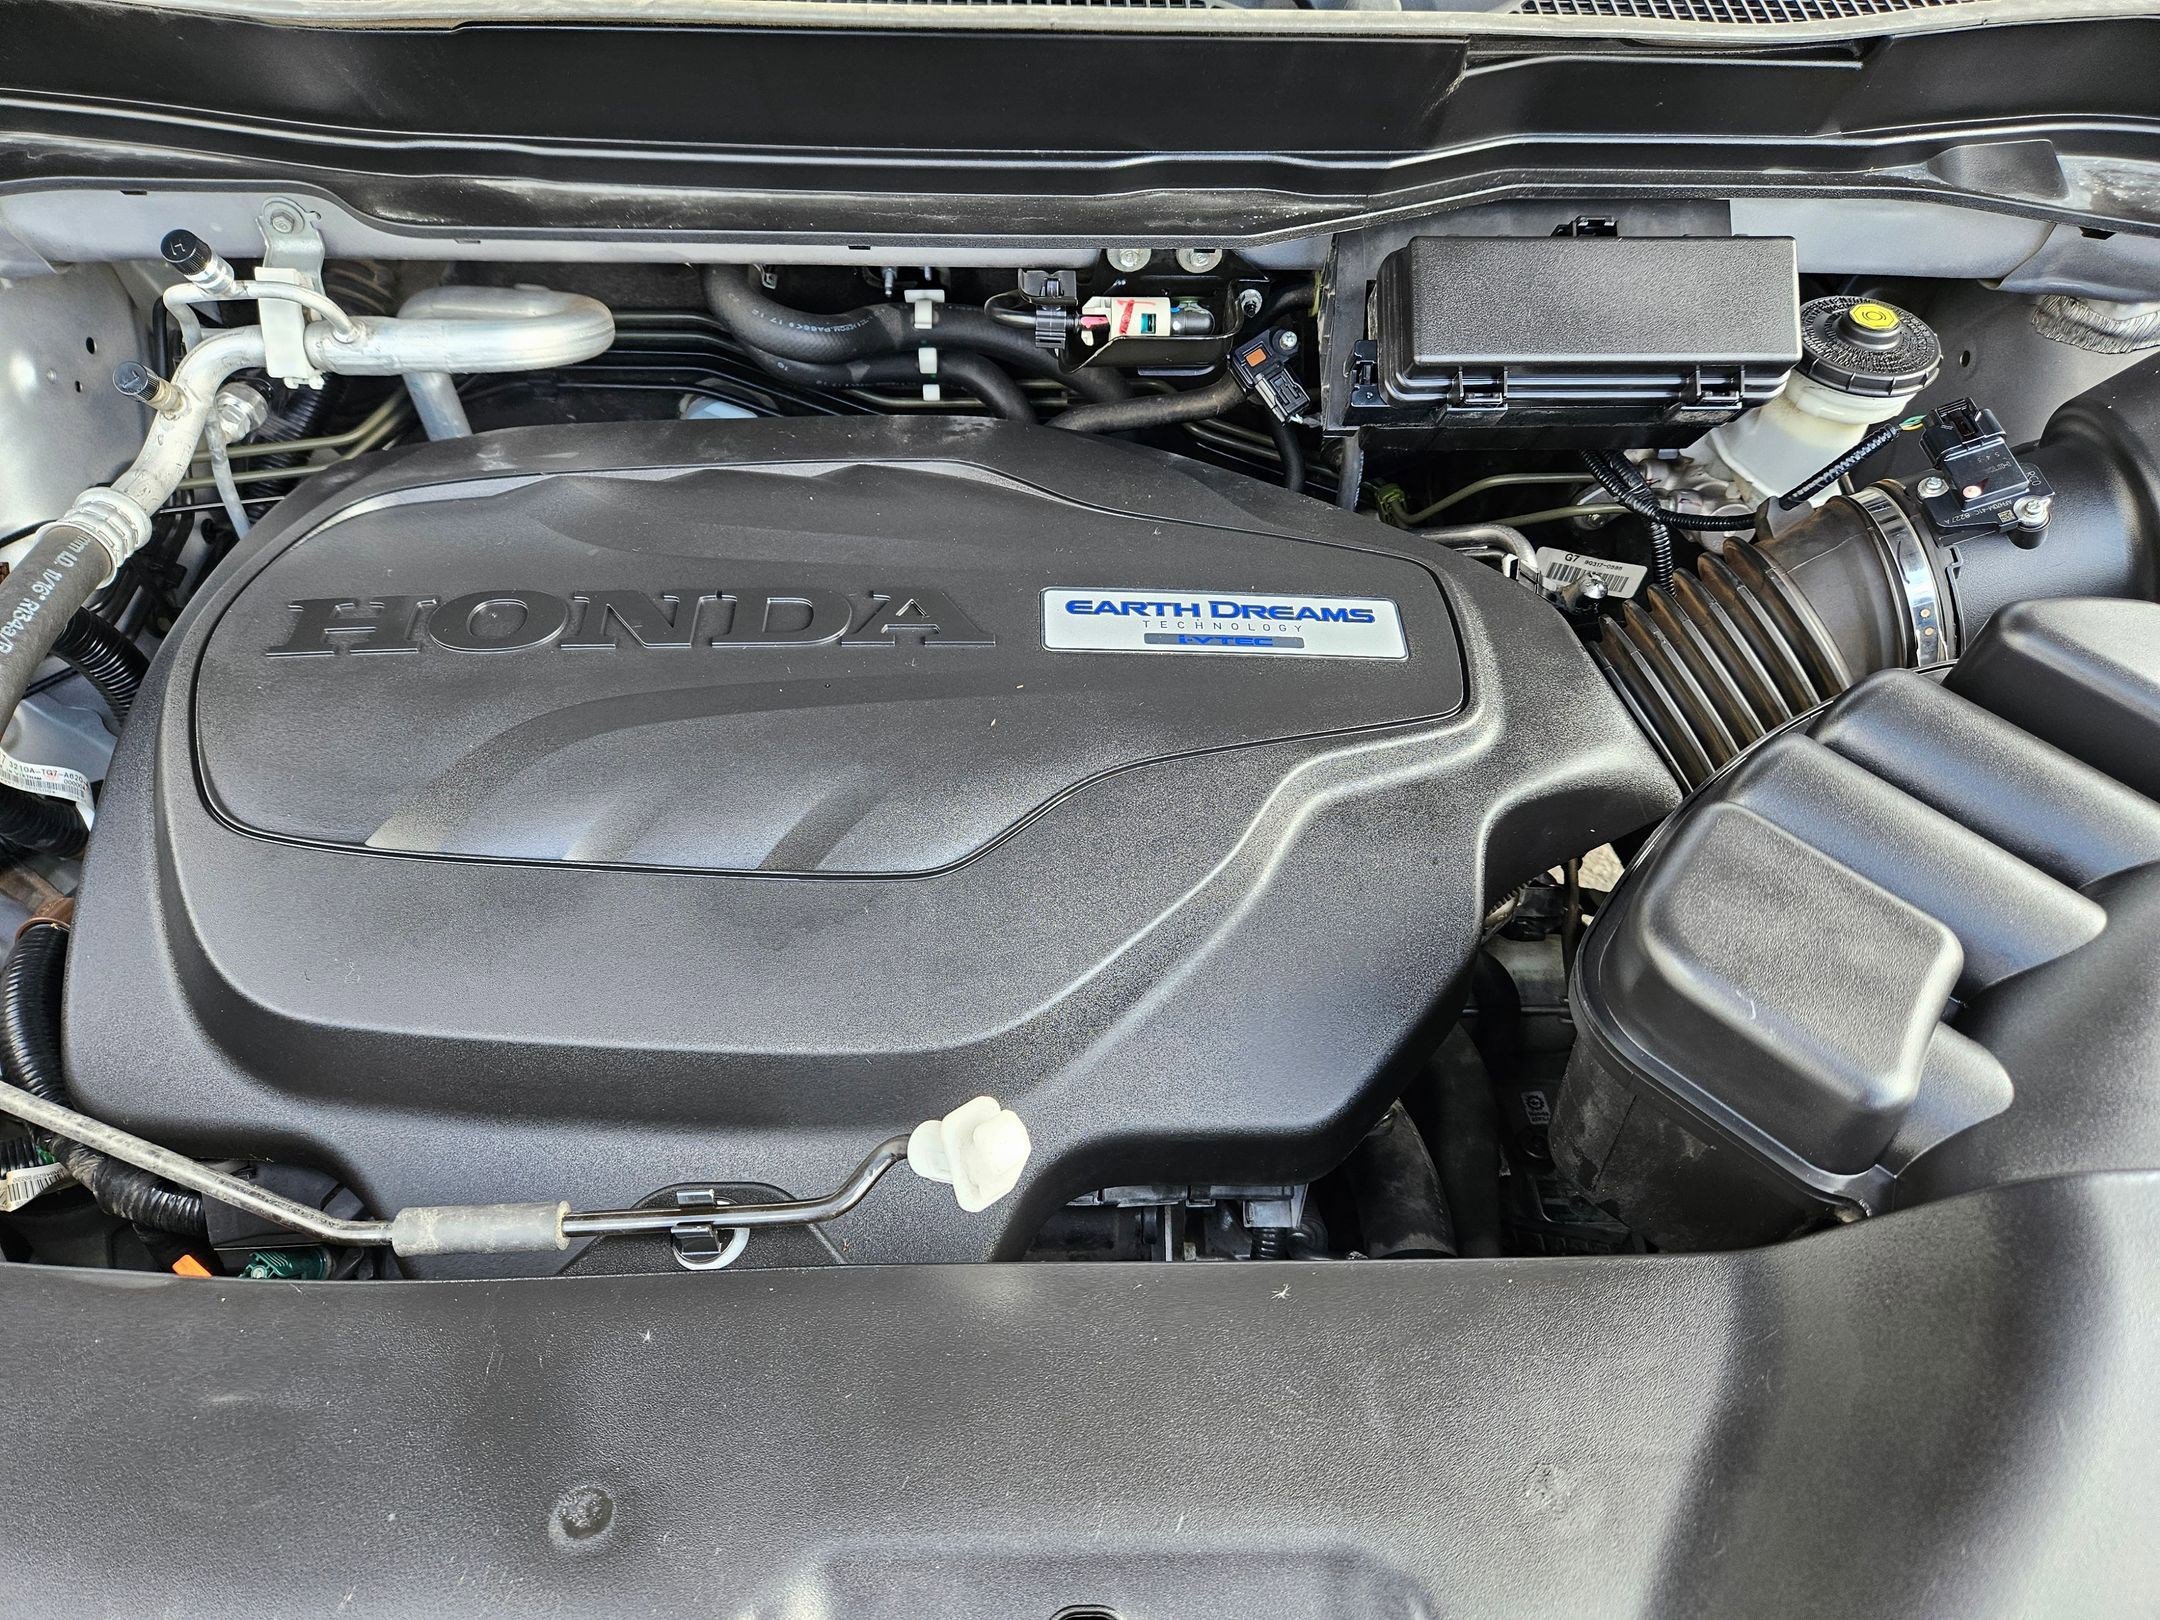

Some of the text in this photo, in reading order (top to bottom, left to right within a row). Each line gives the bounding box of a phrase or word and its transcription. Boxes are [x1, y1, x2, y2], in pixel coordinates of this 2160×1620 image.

[1564, 553, 1580, 562] G7
[1064, 599, 1376, 624] EARTH DREAMS
[265, 589, 998, 659] HONDA
[1142, 619, 1303, 633] TECHNOLOGY
